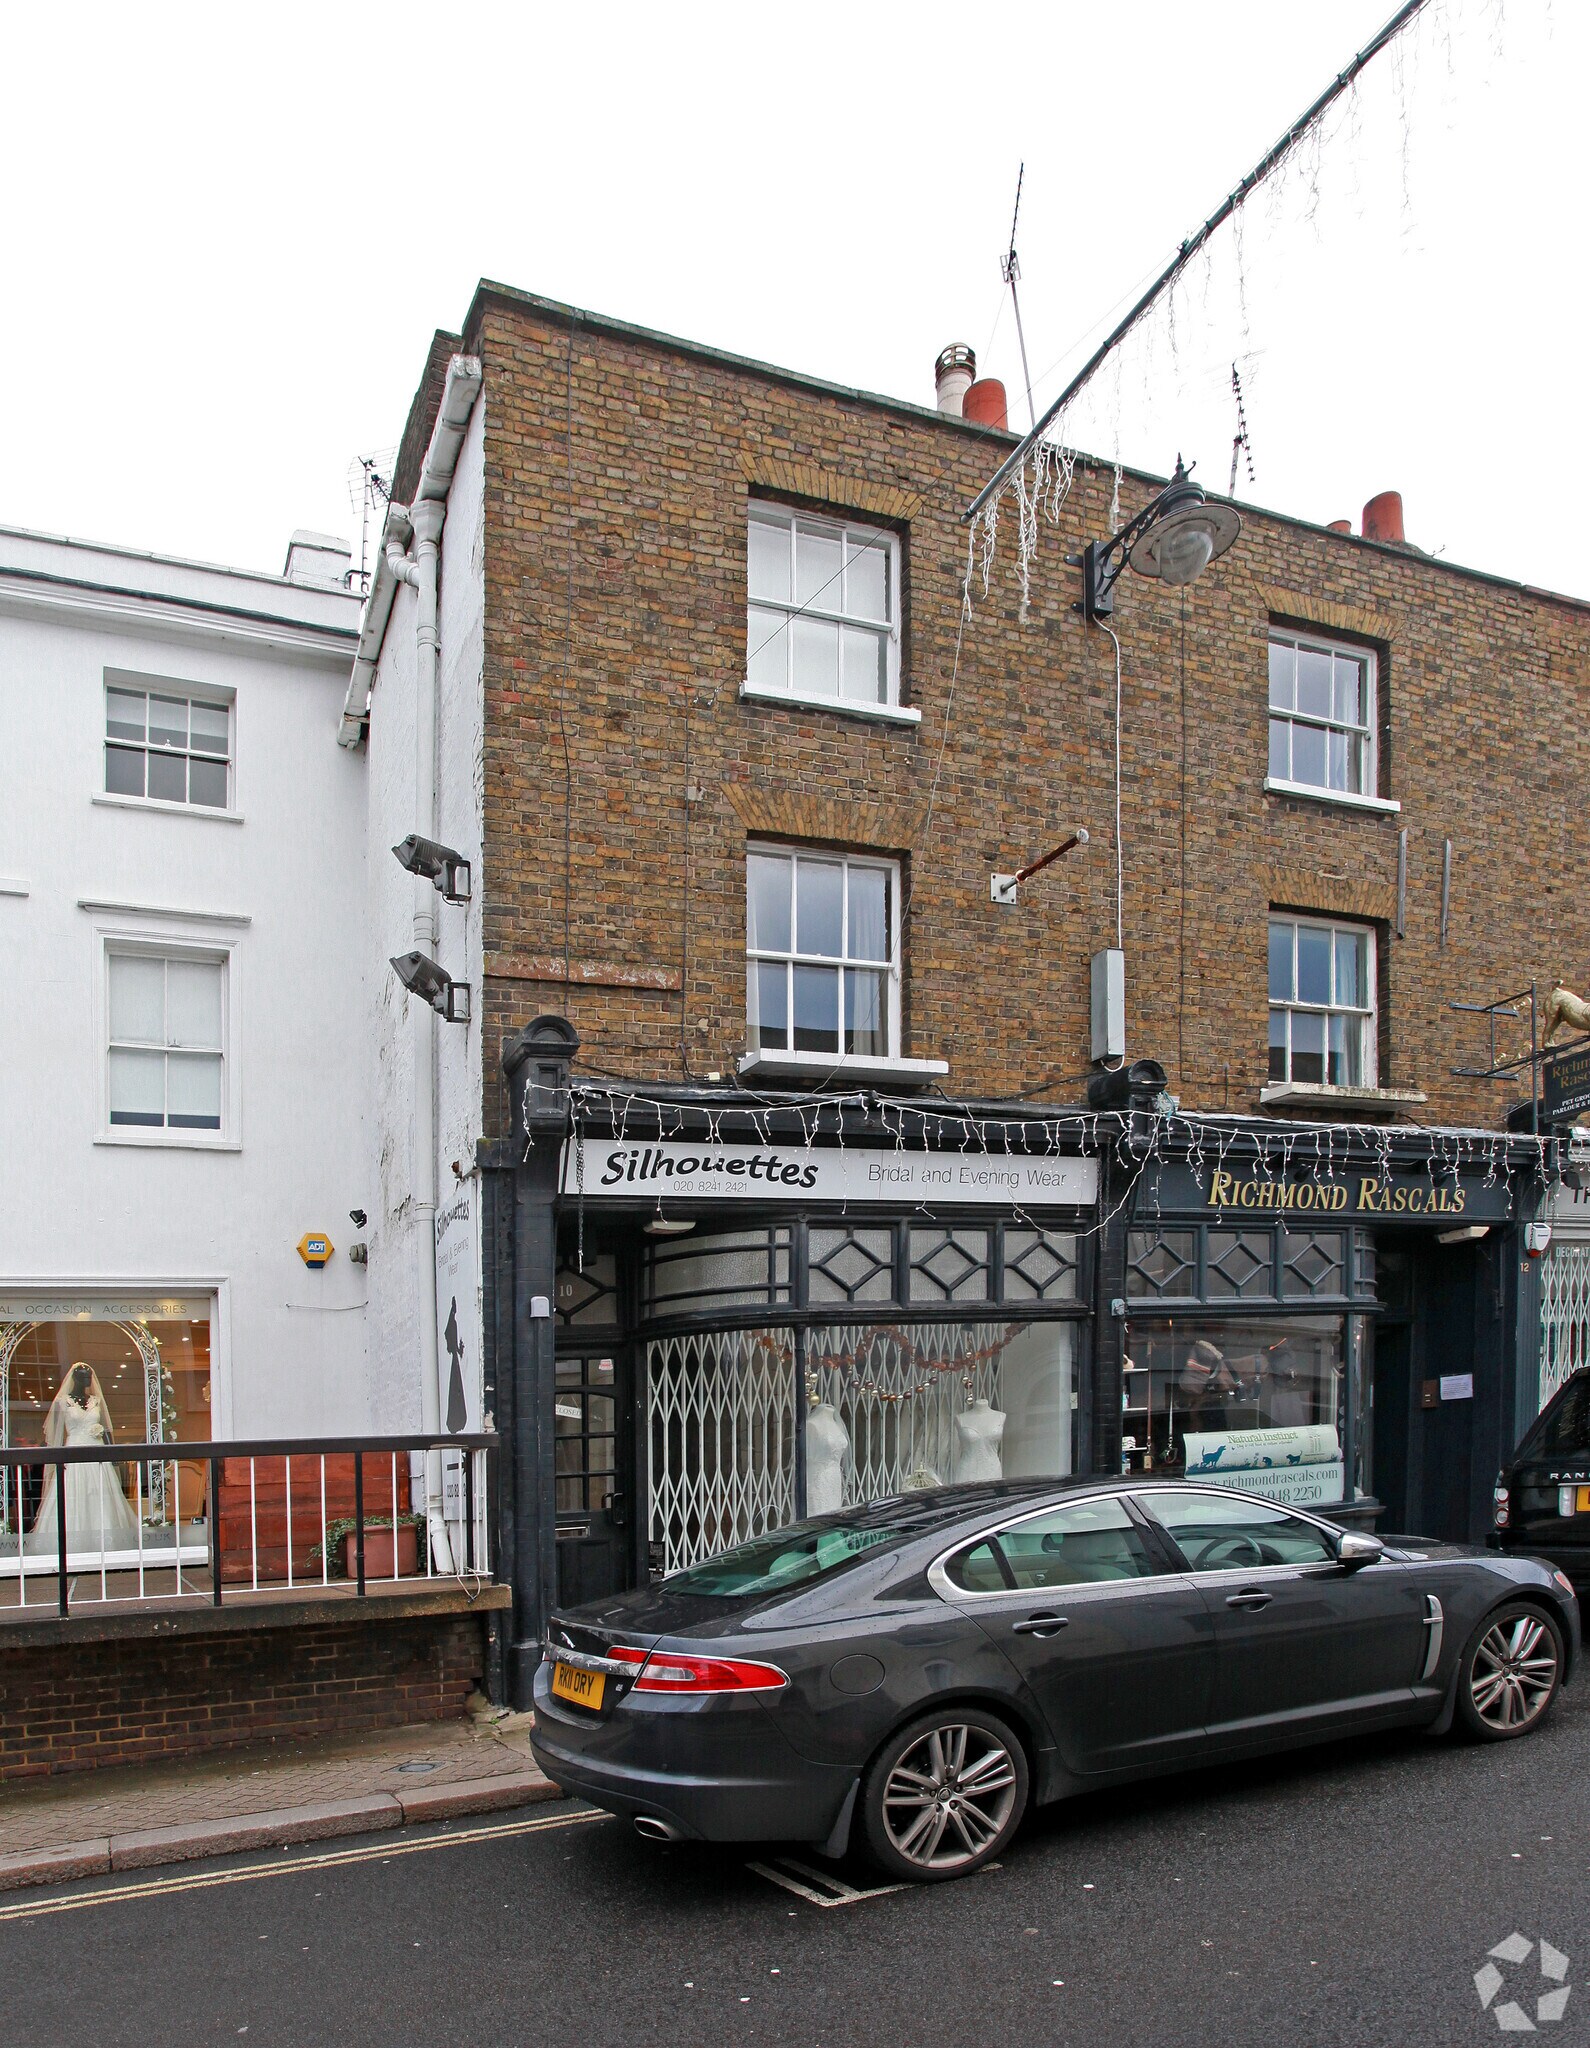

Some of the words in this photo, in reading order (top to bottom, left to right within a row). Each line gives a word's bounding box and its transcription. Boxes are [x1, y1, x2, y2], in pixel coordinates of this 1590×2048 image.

[1562, 1097, 1574, 1107] PET
[1552, 1102, 1580, 1116] PARLOUR
[600, 1148, 819, 1188] Silhouettes
[868, 1163, 913, 1182] Bridal
[921, 1166, 952, 1183] and
[959, 1167, 1019, 1188] Evening
[1026, 1169, 1066, 1186] Wear
[673, 1180, 694, 1192] 020
[698, 1180, 721, 1192] 8241
[725, 1181, 748, 1193] 2421
[436, 1197, 470, 1245] Silhouettes
[308, 1243, 325, 1251] ADT
[1520, 1262, 1530, 1272] 12
[559, 1284, 573, 1297] 10
[25, 1304, 92, 1315] OCCASION
[102, 1304, 187, 1314] ACCESSORIES
[1227, 1433, 1261, 1445] Natural
[1264, 1431, 1299, 1442] Instinct
[1550, 1472, 1590, 1480] RAN
[1293, 1485, 1322, 1501] 2250
[573, 1671, 595, 1697] ORY
